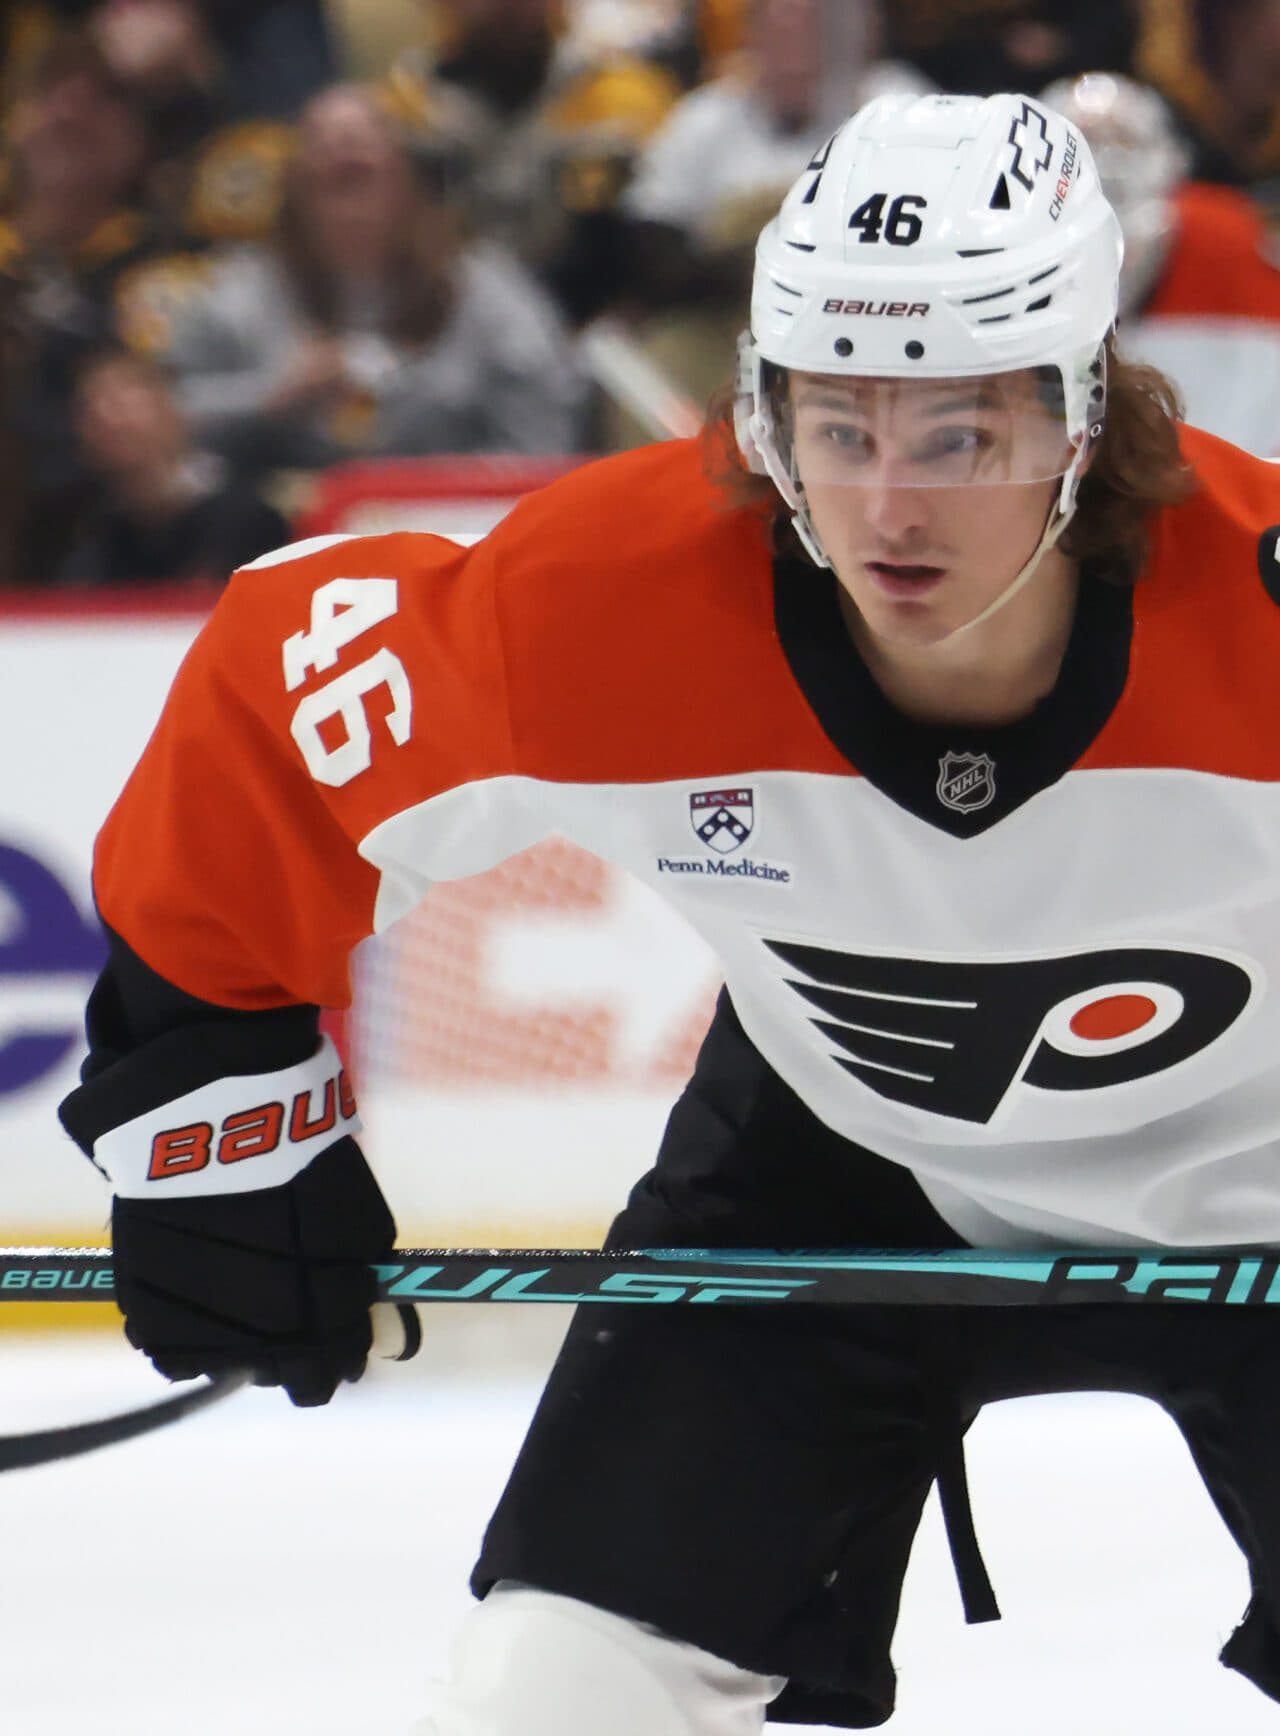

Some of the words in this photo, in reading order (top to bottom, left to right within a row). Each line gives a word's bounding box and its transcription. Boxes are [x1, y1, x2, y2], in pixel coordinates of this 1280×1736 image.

[1048, 130, 1077, 222] CHEVROLET
[848, 193, 927, 246] 46
[282, 577, 412, 788] 46
[950, 769, 983, 798] NHL
[657, 858, 703, 872] Penn
[706, 859, 790, 882] Medicine
